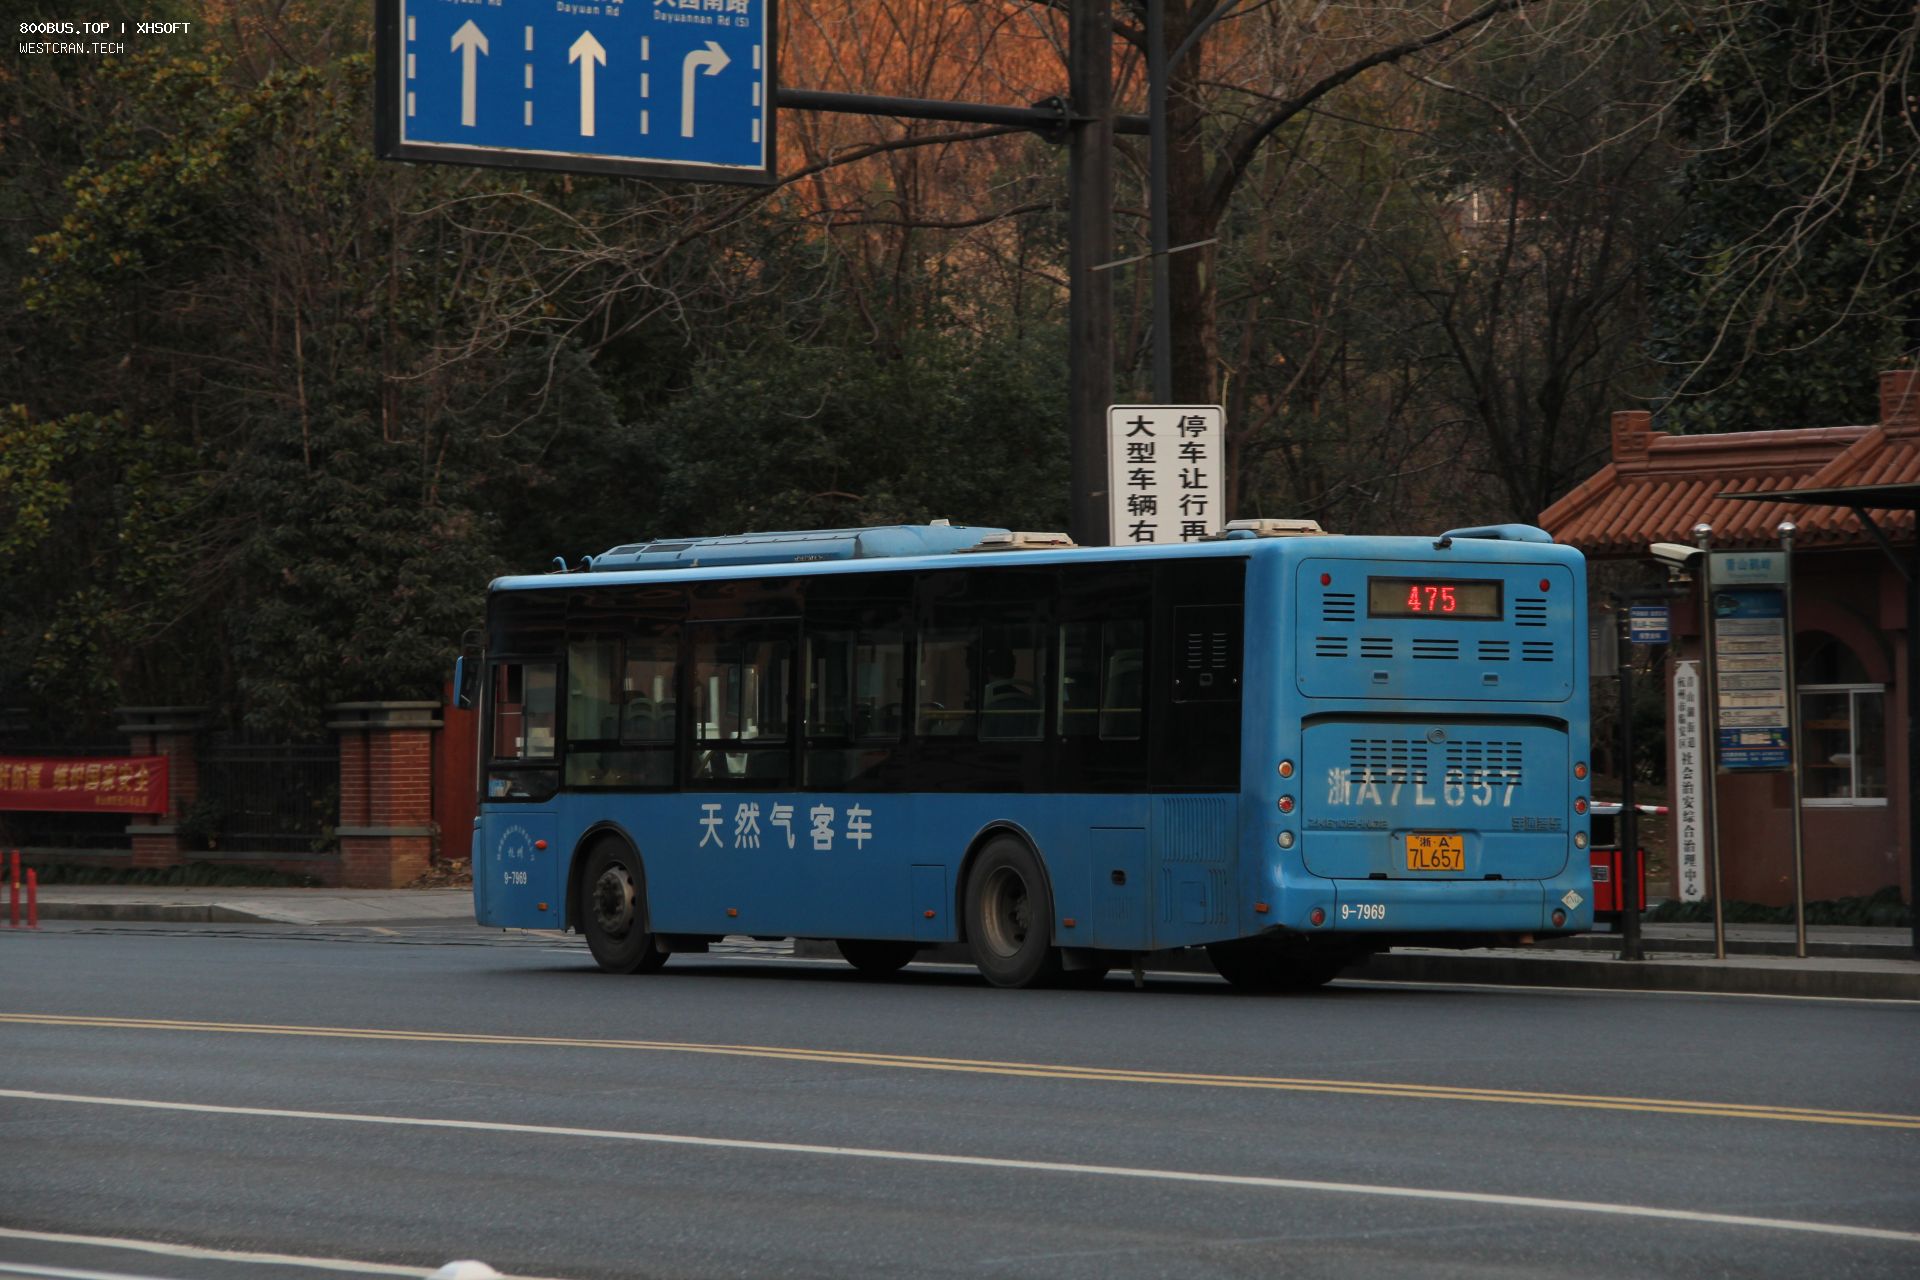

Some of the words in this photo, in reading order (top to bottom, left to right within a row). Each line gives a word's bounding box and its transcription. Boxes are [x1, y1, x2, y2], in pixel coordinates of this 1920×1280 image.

[556, 1, 600, 15] Dayuan
[605, 5, 620, 16] Rd
[653, 9, 713, 24] Dayuannan
[717, 15, 731, 26] Rd
[734, 17, 750, 27] (S)
[1126, 415, 1158, 543] 大型车辆右
[1176, 414, 1208, 542] 停车让行再
[1407, 586, 1456, 612] 475
[699, 801, 873, 851] 天然气客车
[1682, 752, 1698, 896] 社会治安综合治理中心
[1409, 848, 1461, 868] 7L657
[503, 871, 528, 885] 9-7969
[1340, 904, 1387, 921] 9-7969
